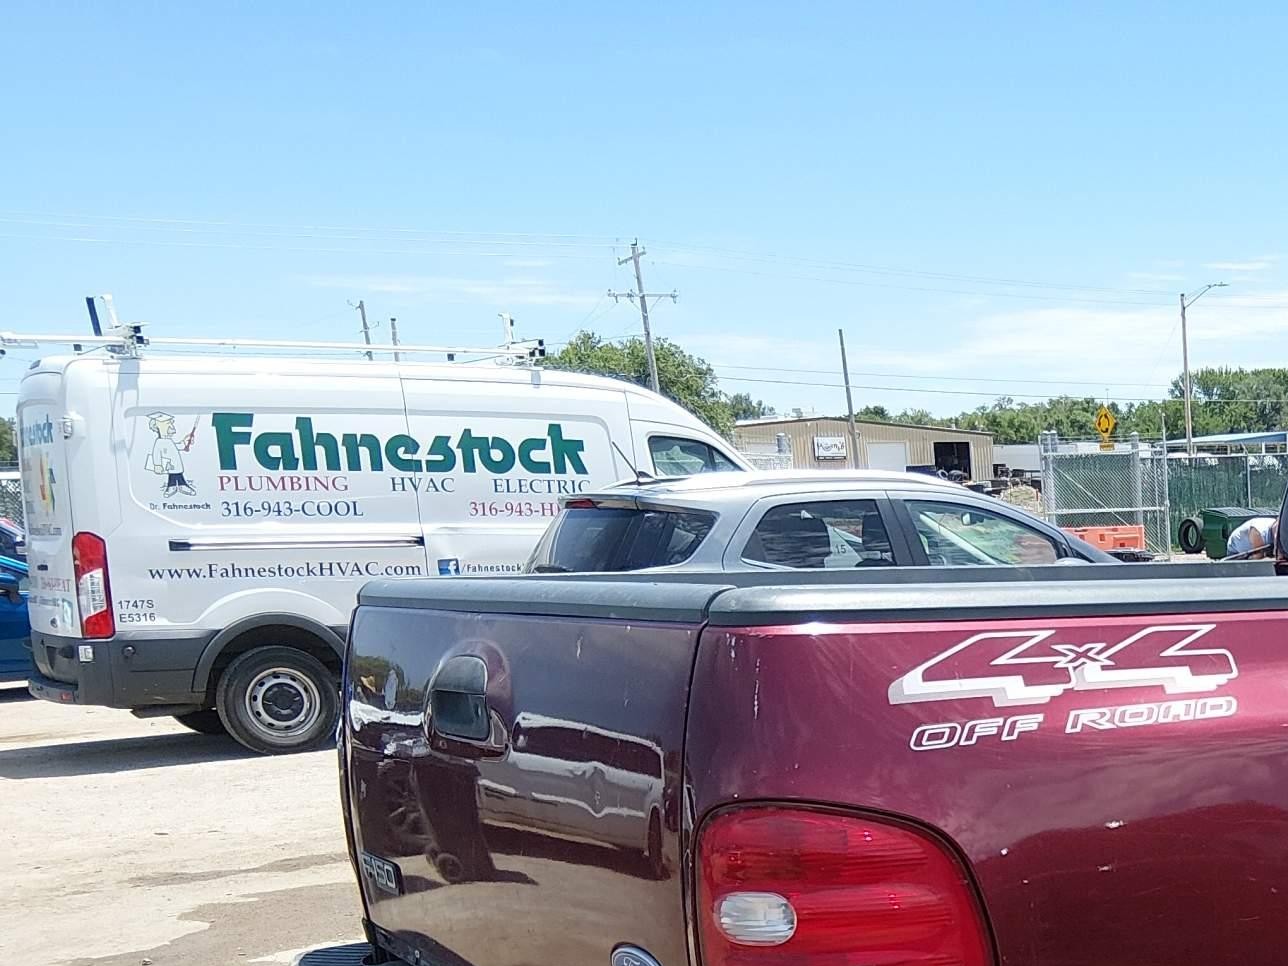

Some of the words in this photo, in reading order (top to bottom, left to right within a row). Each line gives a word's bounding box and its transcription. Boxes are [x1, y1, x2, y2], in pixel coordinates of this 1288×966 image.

[211, 412, 589, 475] Fahnestock
[217, 475, 349, 492] PLUMBING
[390, 477, 456, 493] HVAC
[493, 478, 591, 494] ELECTRIC
[162, 502, 211, 510] Fahnestock
[221, 500, 364, 517] 316-943-COOL
[148, 561, 422, 579] www.FahnestockHVAC.com
[461, 562, 524, 573] /Fahnestock
[118, 599, 155, 610] 1747S
[119, 612, 156, 623] E5316
[888, 623, 1239, 708] 4x4
[910, 713, 1044, 751] OFF
[1065, 696, 1237, 734] ROAD
